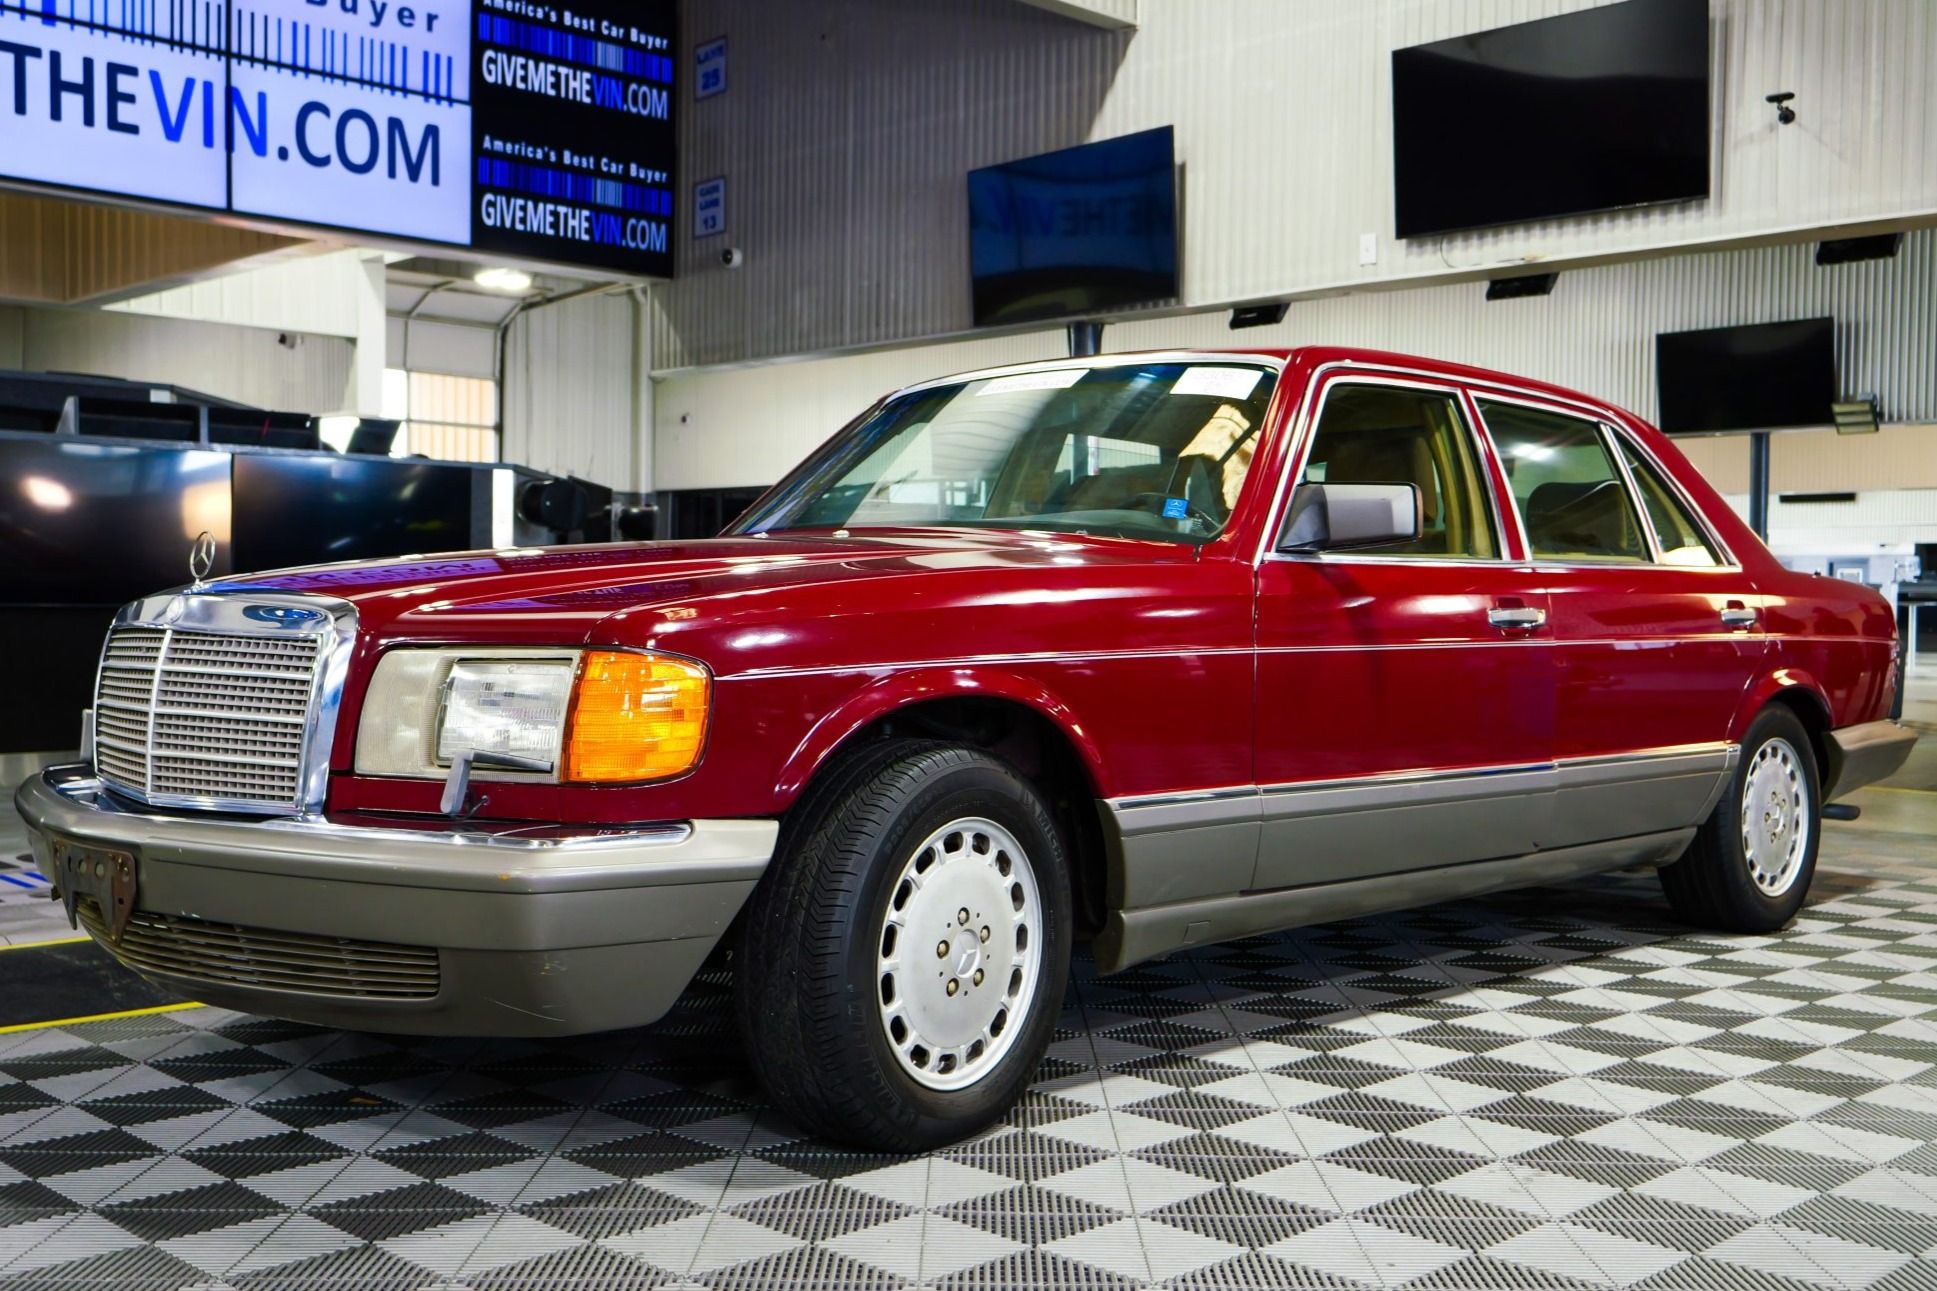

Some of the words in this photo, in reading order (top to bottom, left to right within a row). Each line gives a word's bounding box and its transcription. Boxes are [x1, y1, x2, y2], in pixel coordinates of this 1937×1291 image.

[305, 0, 439, 33] uyer
[563, 10, 595, 33] Best
[601, 20, 625, 39] Car
[630, 27, 668, 49] Buyer
[482, 49, 668, 120] GIVEMETHEVIN.COM
[483, 134, 557, 162] America's
[563, 149, 594, 170] Best
[600, 157, 624, 175] Car
[629, 162, 667, 184] Buyer
[481, 193, 667, 254] GIVEMETHEVIN.COM
